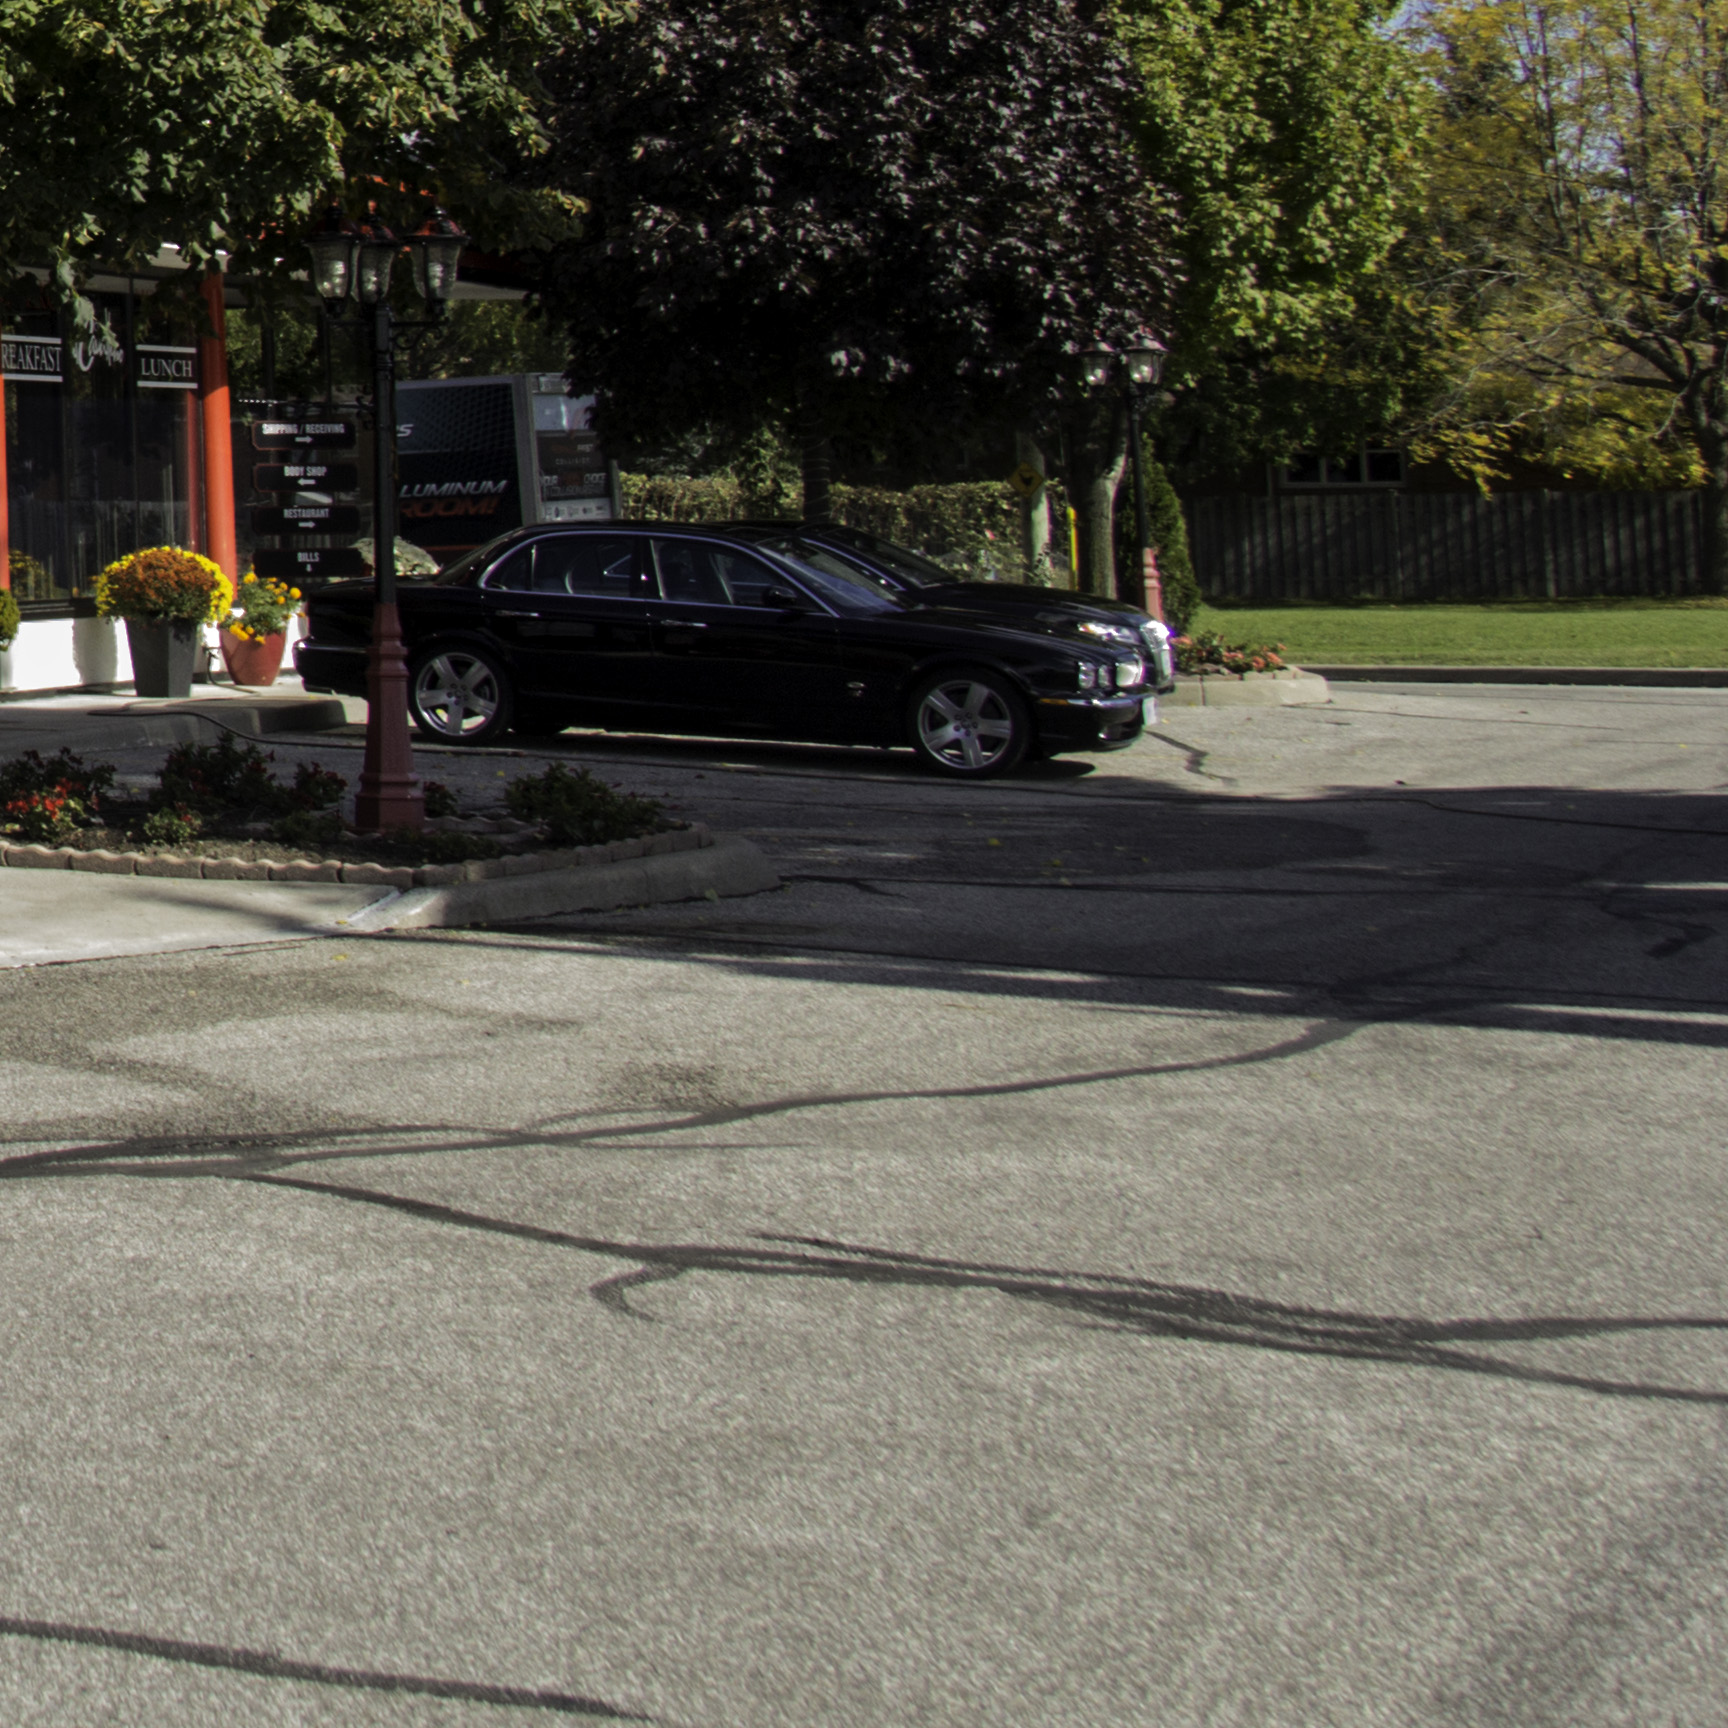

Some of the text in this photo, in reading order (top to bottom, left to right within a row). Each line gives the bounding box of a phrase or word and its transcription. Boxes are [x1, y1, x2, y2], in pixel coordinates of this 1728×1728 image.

[1, 342, 63, 373] REAKFAST
[140, 356, 194, 378] LUNCH
[262, 423, 299, 435] SHIPPING
[305, 423, 346, 435] RECEIVING
[284, 465, 328, 478] BODY SHOP
[399, 479, 509, 498] LUMINUM
[283, 507, 331, 520] RESTAURANT
[297, 551, 321, 563] BILLS
